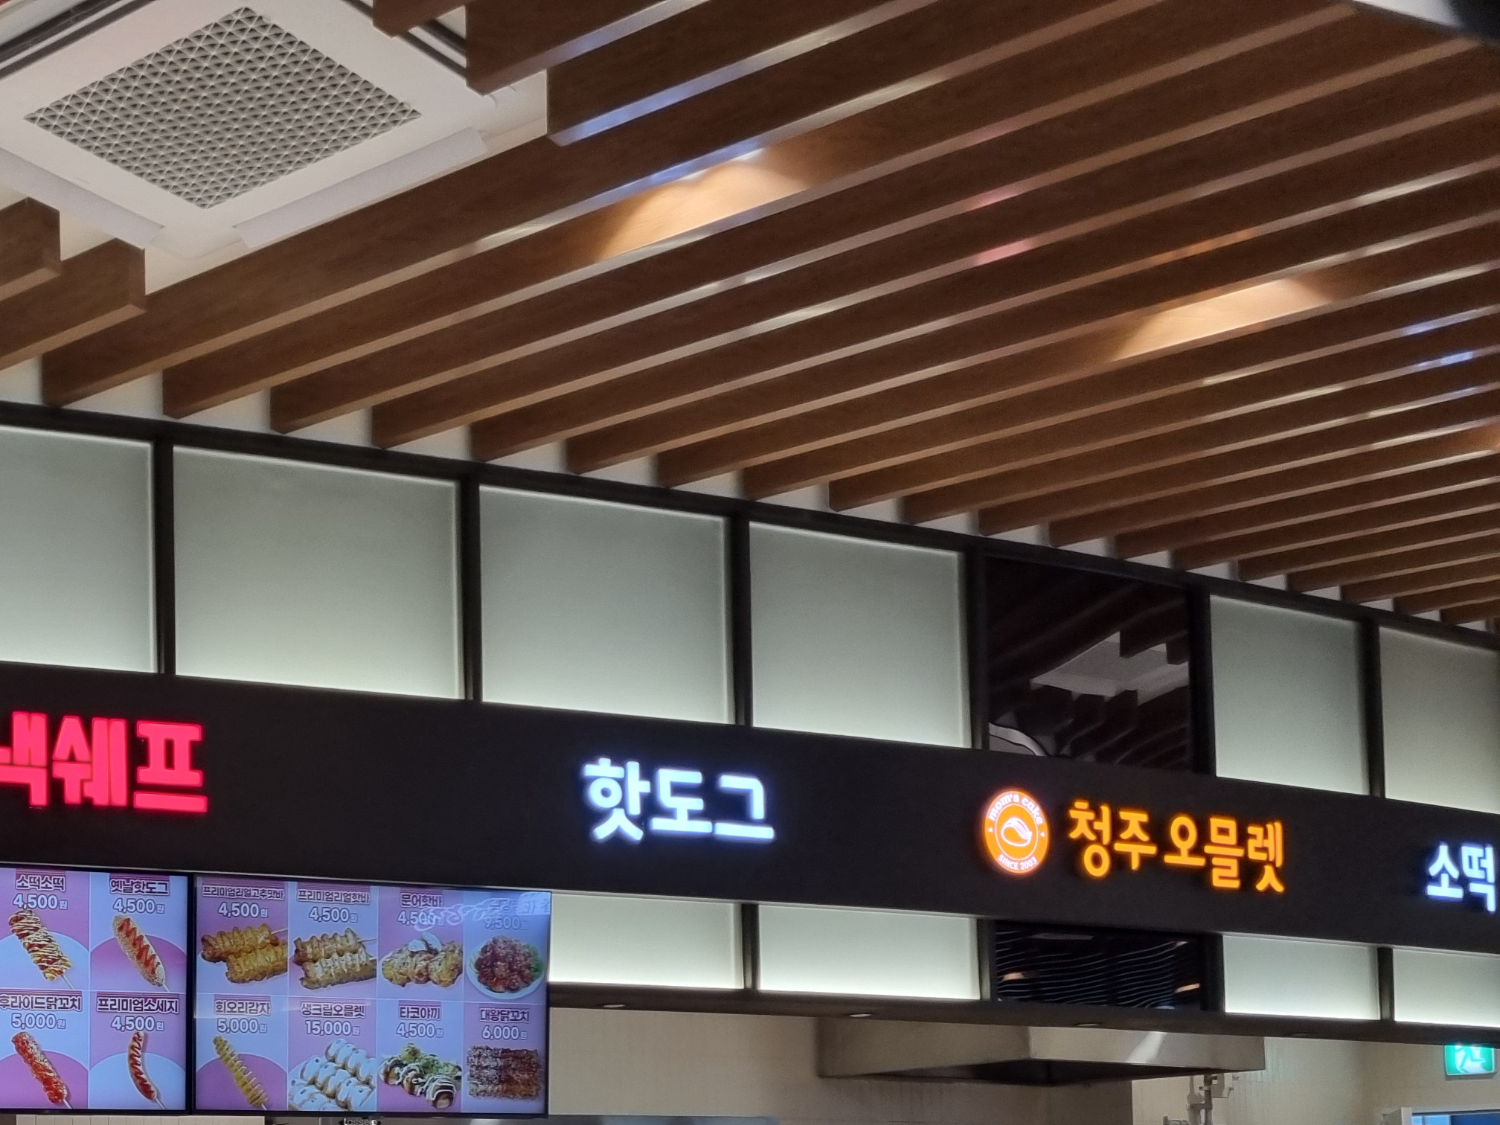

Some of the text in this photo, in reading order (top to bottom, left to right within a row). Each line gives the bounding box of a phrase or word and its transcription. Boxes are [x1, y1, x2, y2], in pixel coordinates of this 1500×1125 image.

[583, 757, 775, 844] 핫도그
[989, 794, 1044, 825] mom's cake
[1067, 798, 1286, 894] 청주 오믈렛
[998, 854, 1037, 870] SINCE 2003
[16, 875, 66, 892] 소떡소떡
[1426, 844, 1496, 912] 소떡
[109, 878, 170, 896] 옛날핫도그
[400, 892, 443, 908] 문어핫바
[97, 996, 179, 1014] 프리미엄소세지
[215, 1000, 271, 1015] 회오리감자
[301, 1003, 365, 1018] 생크림오믈렛
[399, 1006, 441, 1021] 타코야끼
